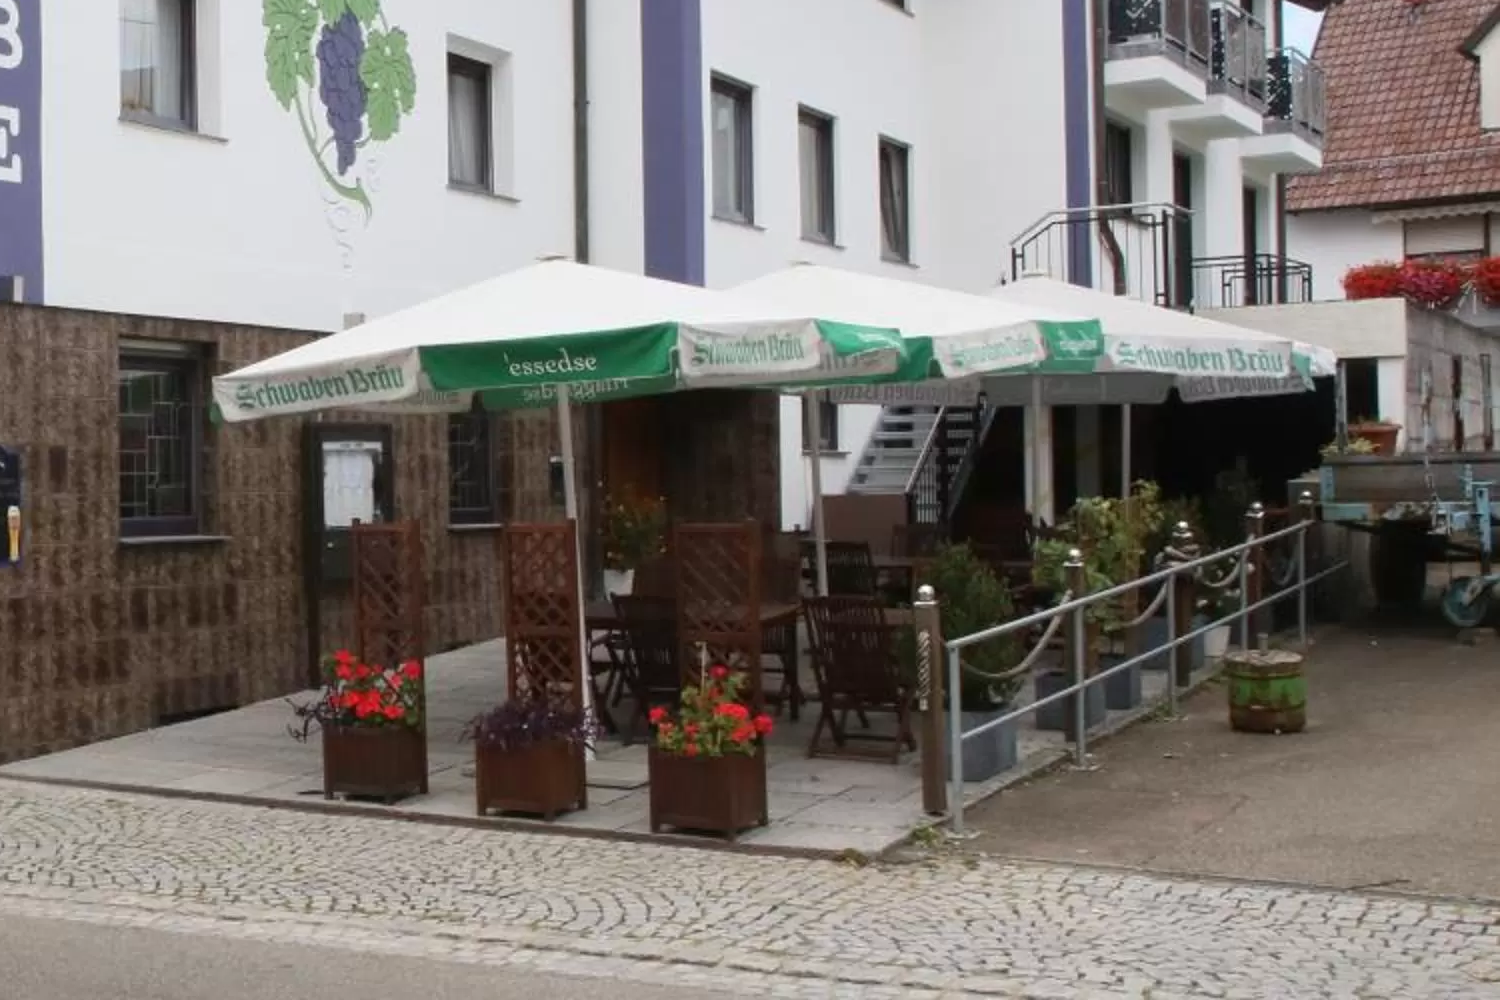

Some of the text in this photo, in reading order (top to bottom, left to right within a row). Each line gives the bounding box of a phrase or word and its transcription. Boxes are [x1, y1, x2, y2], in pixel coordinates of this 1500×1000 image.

[1116, 341, 1223, 371] Schwaben
[1226, 347, 1284, 373] Bräu
[235, 364, 405, 410] Schwaben Bräu
